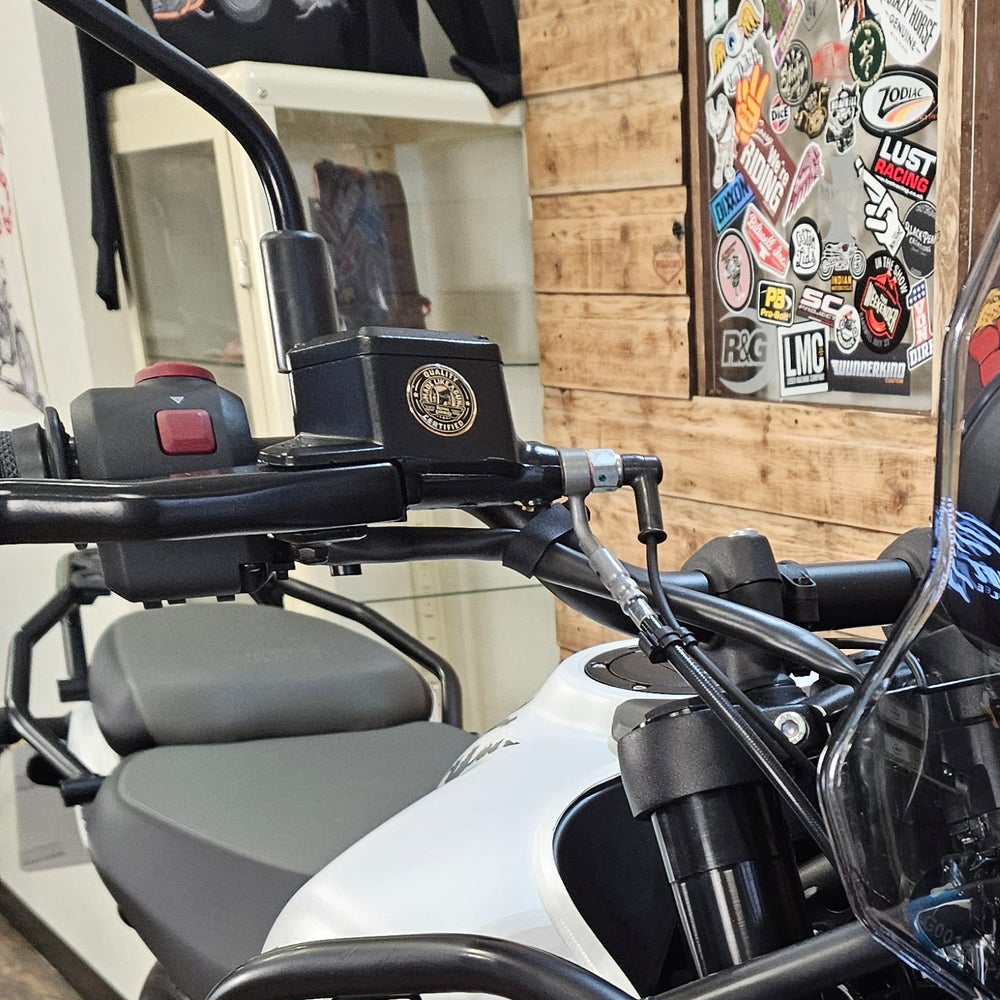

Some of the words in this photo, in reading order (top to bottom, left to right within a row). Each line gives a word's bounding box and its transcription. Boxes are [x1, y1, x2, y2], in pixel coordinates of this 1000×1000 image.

[889, 14, 918, 51] GENUINE
[908, 4, 938, 53] HORSE
[771, 106, 788, 121] DICE
[878, 86, 923, 119] ZODIAC
[880, 136, 937, 177] LUST
[739, 139, 785, 213] RIDING
[875, 158, 930, 194] RACING
[715, 178, 750, 223] DIXXON
[765, 286, 786, 310] PB
[800, 287, 844, 315] SC
[723, 332, 768, 363] R&G
[784, 331, 825, 377] LMC
[422, 368, 459, 383] QUALITY
[830, 359, 906, 379] WUNDERKIND
[422, 414, 465, 431] CERTIFIED
